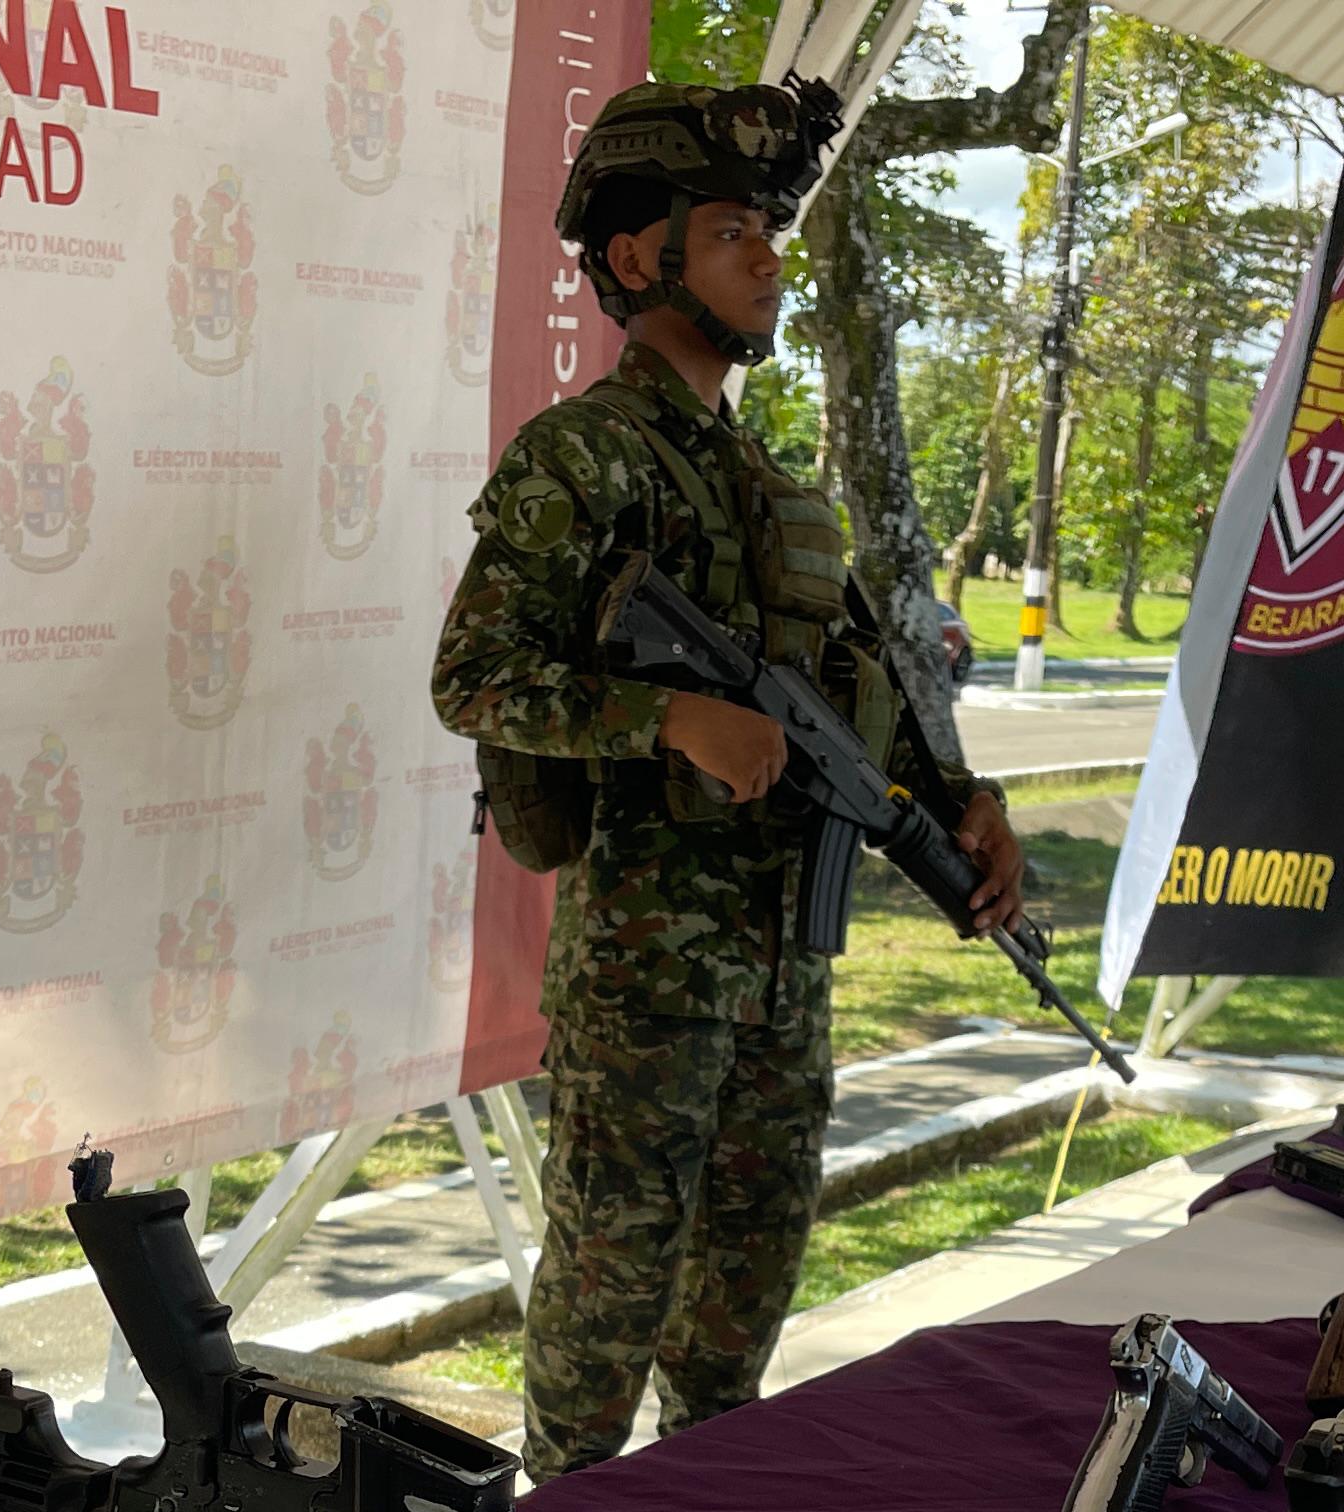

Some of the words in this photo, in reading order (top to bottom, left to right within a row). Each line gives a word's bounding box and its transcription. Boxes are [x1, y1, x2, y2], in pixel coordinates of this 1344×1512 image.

[43, 234, 127, 262] NACIONAL
[34, 622, 117, 643] NACIONAL
[1204, 846, 1230, 905] O
[1225, 847, 1336, 912] MORIR
